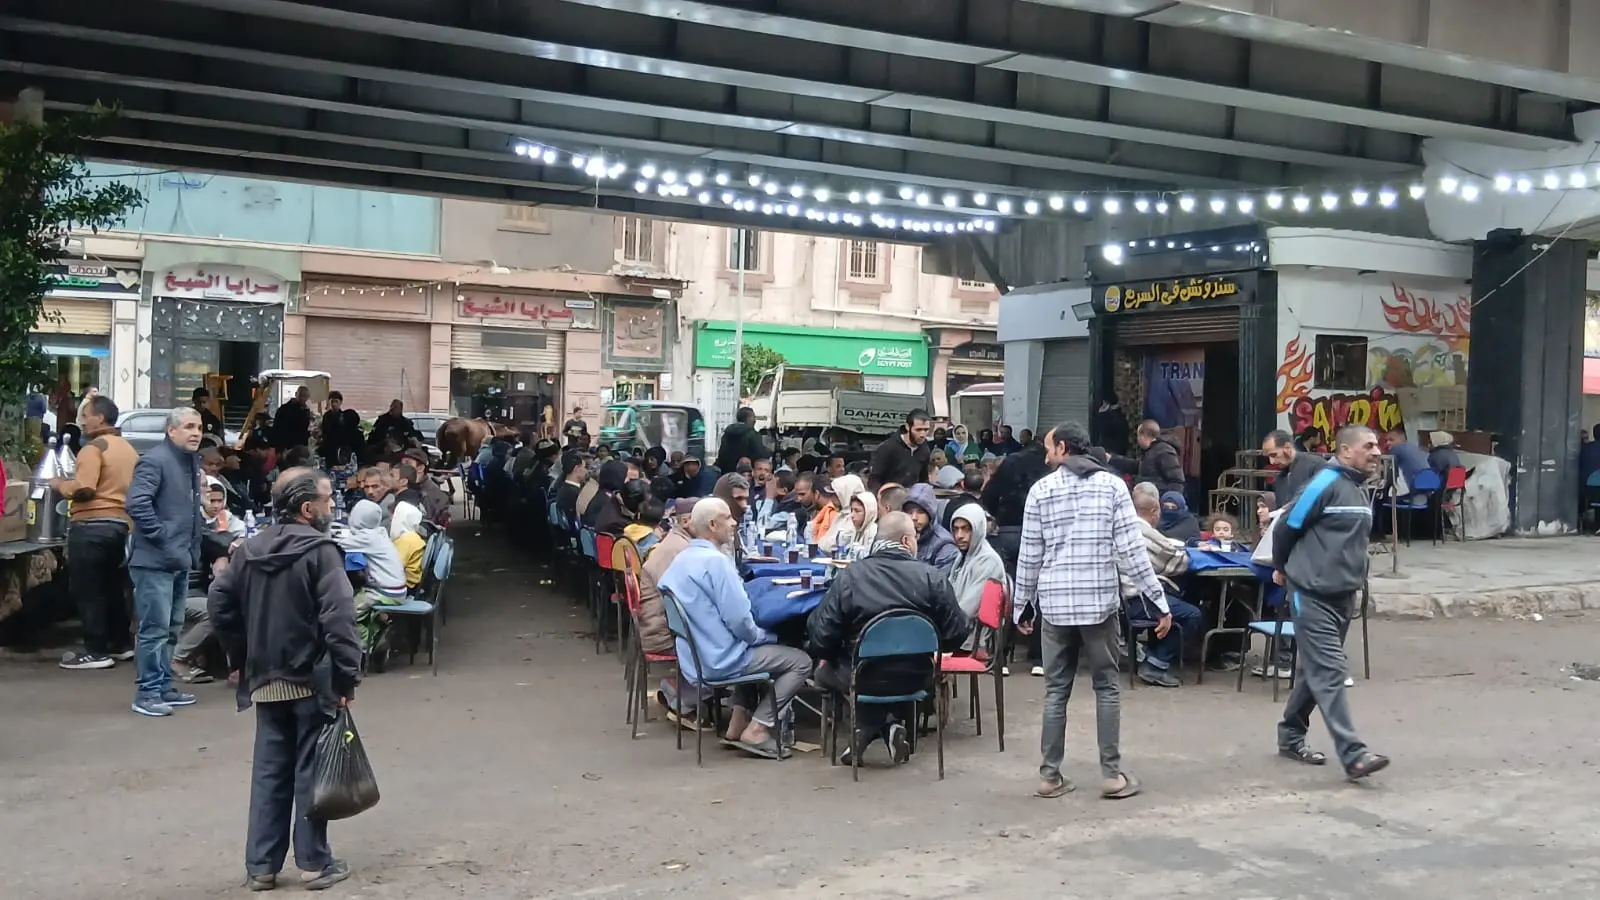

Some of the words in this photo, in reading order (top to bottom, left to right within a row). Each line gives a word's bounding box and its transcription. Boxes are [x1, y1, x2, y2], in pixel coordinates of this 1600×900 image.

[165, 271, 220, 292] الشيخ
[226, 275, 279, 295] سرايا
[463, 297, 515, 316] الشيخ
[521, 302, 573, 320] سرايا
[843, 409, 908, 419] DAIHATS
